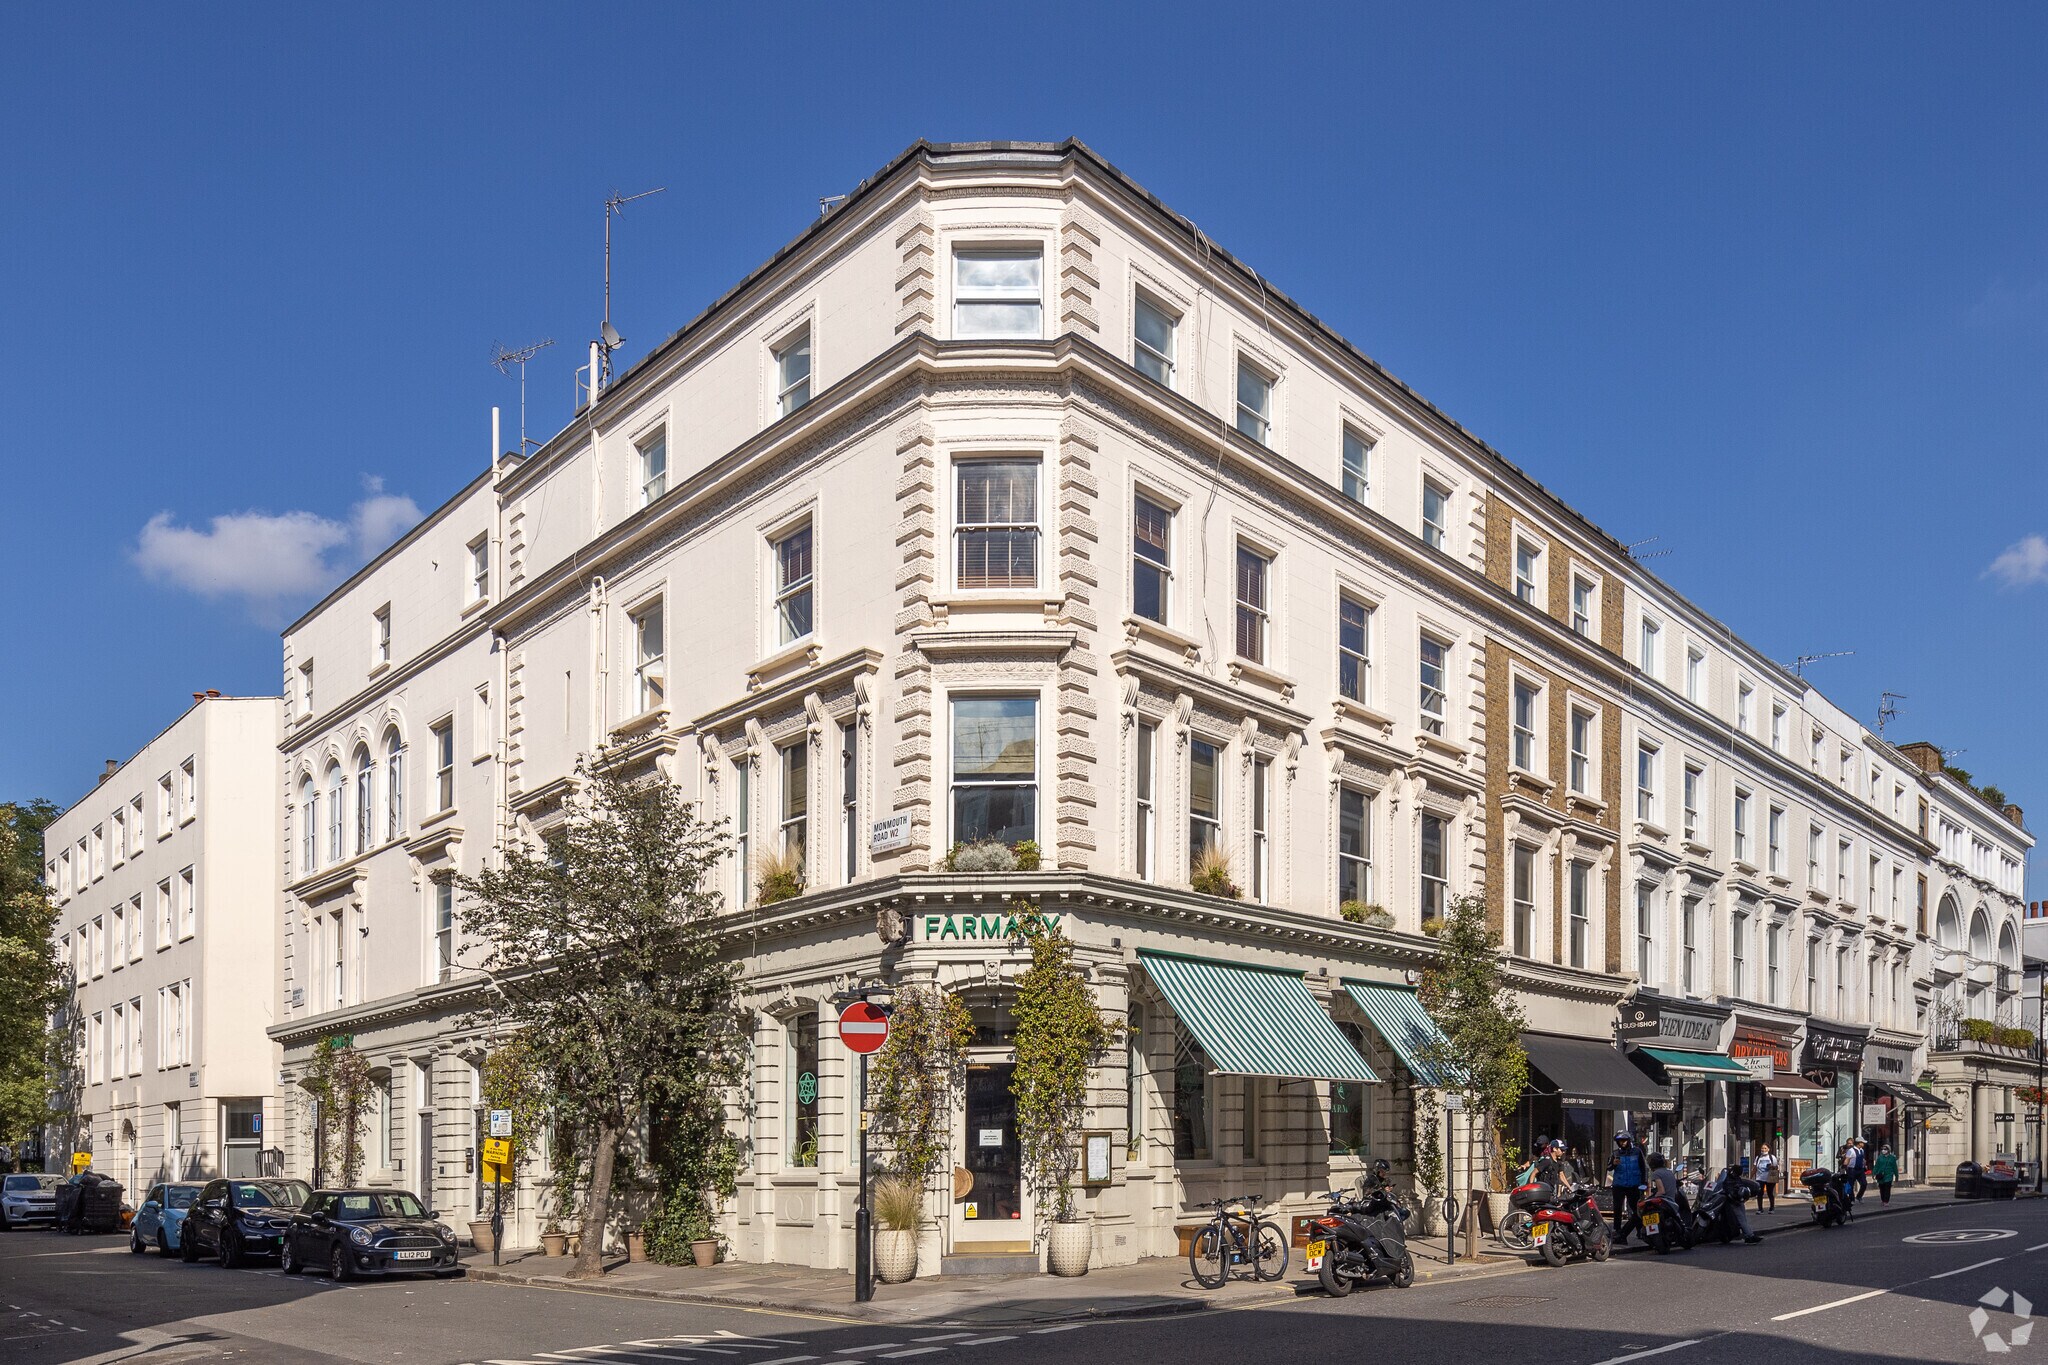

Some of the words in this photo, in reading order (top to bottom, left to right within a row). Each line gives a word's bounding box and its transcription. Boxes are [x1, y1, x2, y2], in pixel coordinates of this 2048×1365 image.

[873, 815, 908, 832] MONMOUTH
[873, 831, 888, 843] ROAD
[890, 829, 899, 839] W2
[925, 915, 1060, 941] FARMACY
[1622, 1020, 1657, 1030] SUSHISHOP
[1681, 1020, 1713, 1041] IDEAS
[1735, 1044, 1752, 1058] DRY
[1652, 1101, 1675, 1111] SUSHISHOP
[400, 1251, 415, 1259] LL12
[1312, 1258, 1319, 1267] L
